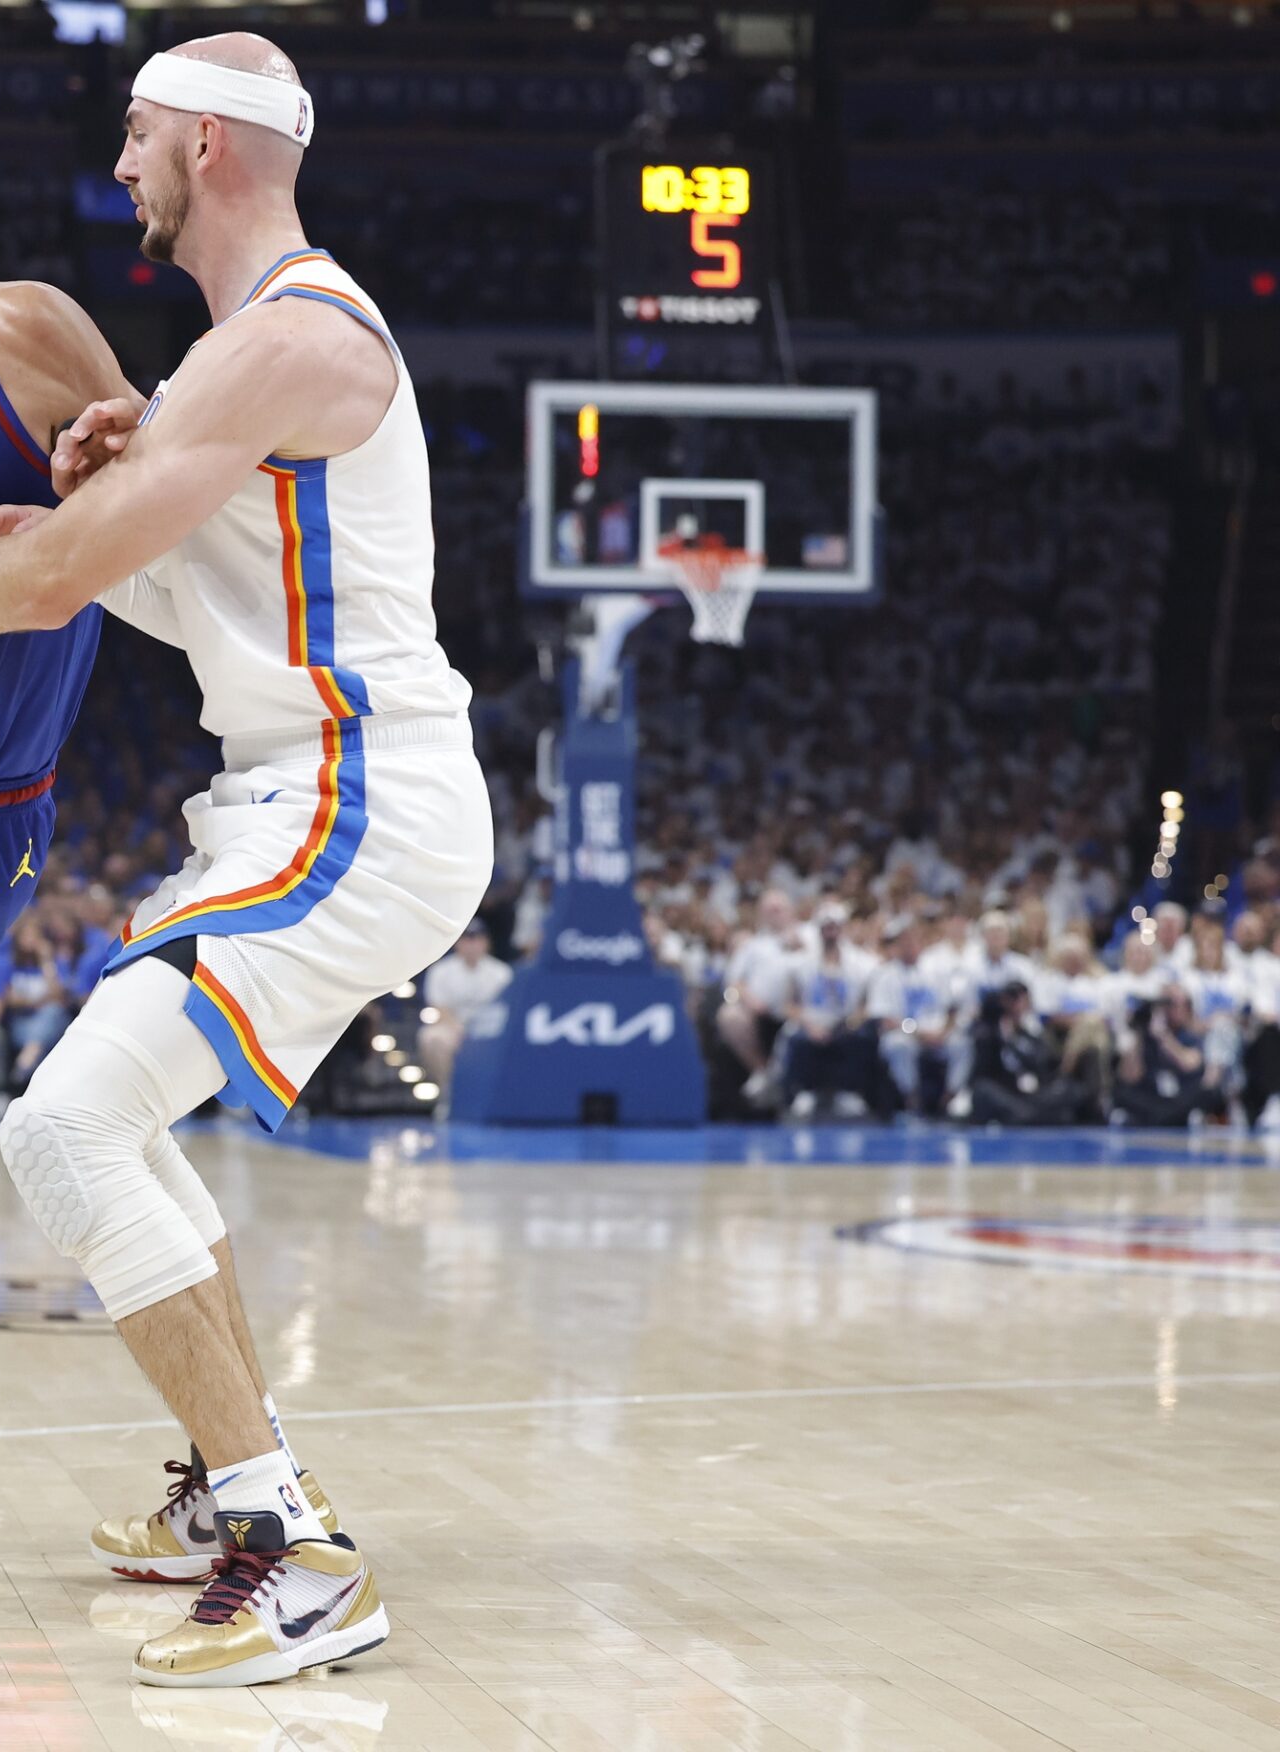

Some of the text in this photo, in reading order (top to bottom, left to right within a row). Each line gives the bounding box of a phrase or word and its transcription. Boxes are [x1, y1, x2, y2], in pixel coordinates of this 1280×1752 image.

[642, 165, 749, 214] 10:33
[691, 212, 741, 288] 5
[556, 927, 642, 965] Google
